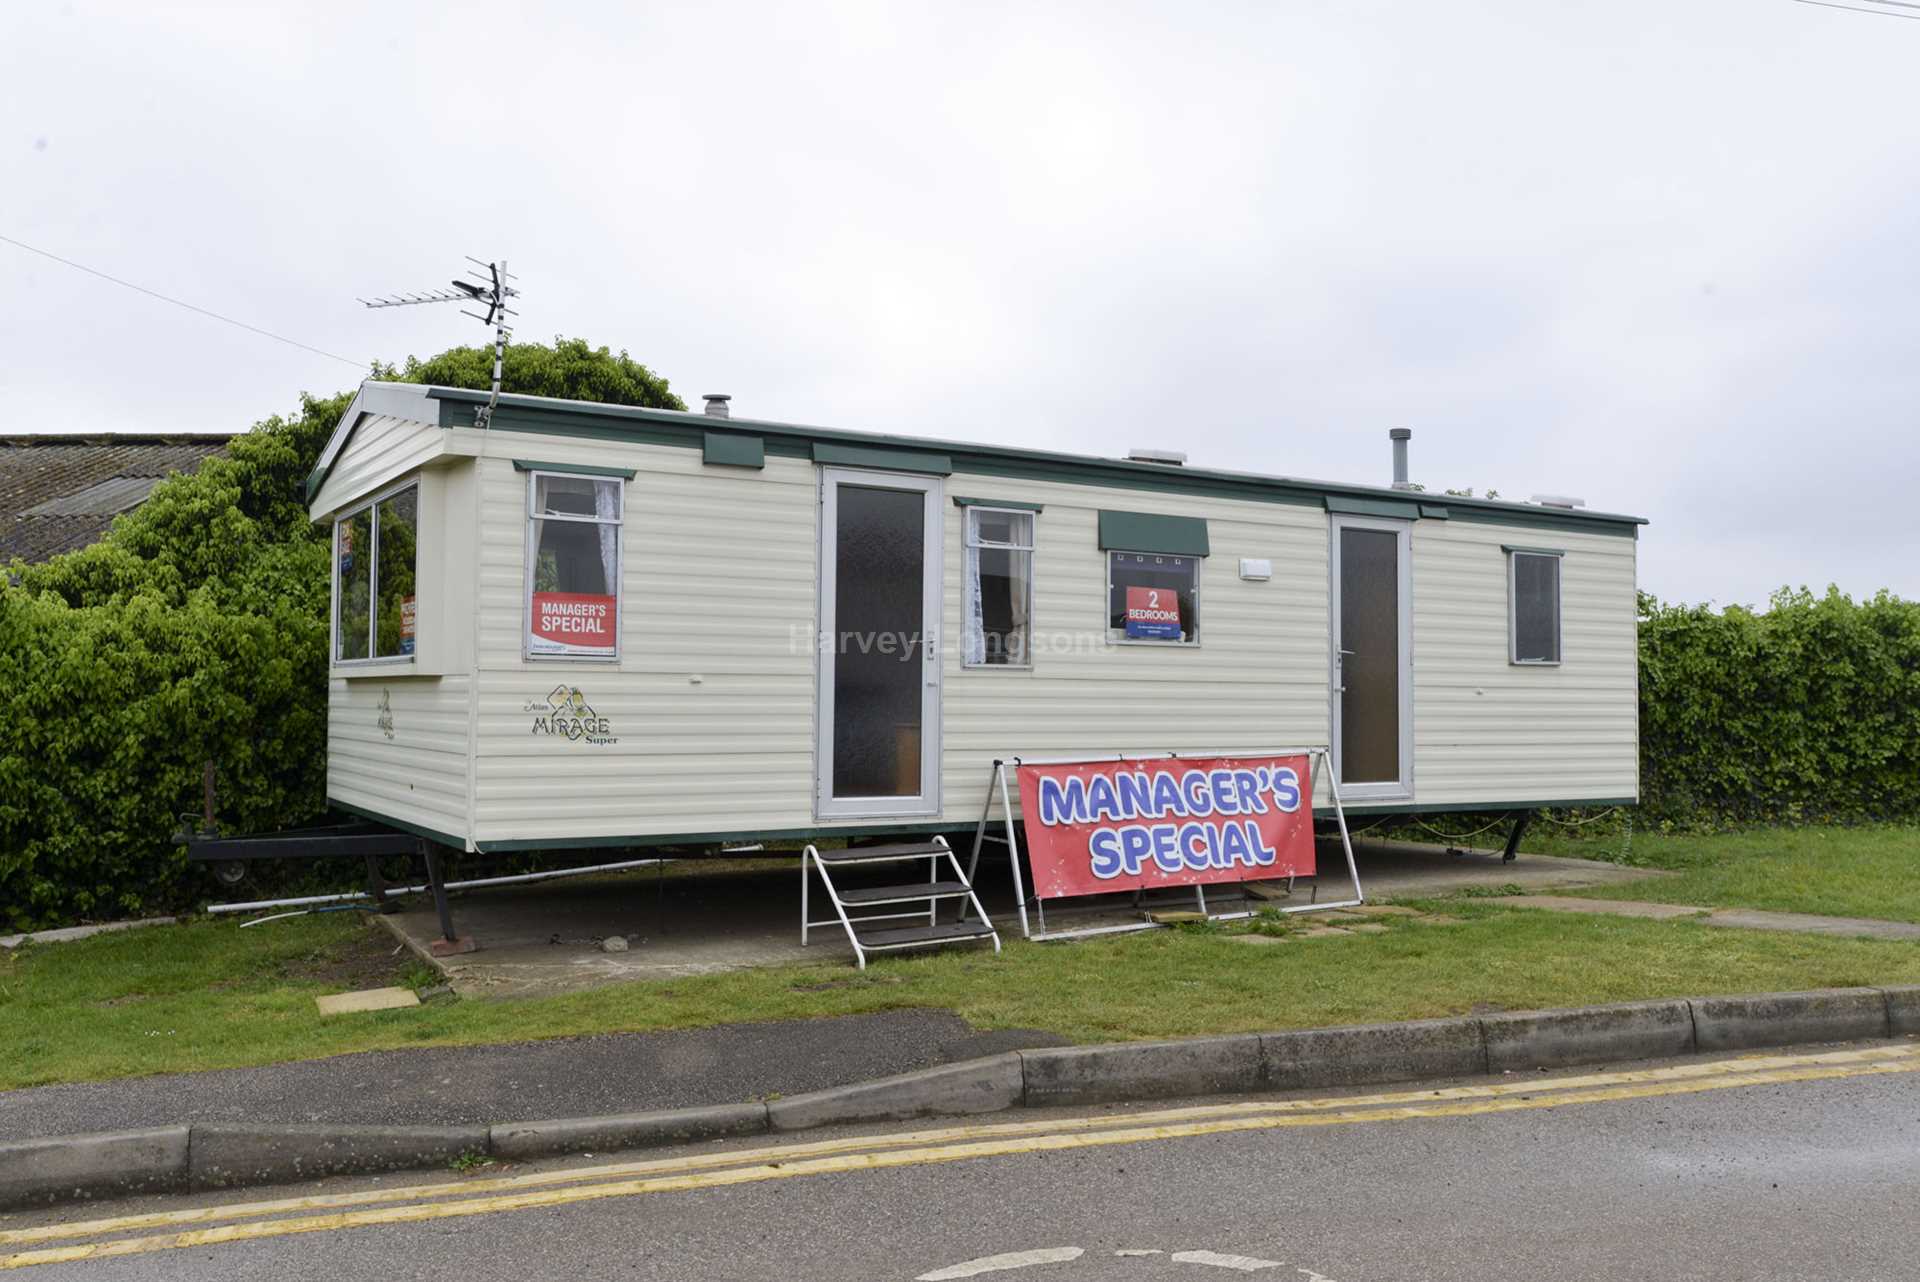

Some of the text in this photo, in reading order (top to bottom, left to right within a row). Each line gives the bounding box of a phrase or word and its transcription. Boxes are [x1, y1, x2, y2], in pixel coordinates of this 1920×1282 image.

[1149, 591, 1159, 608] 2
[542, 602, 607, 617] MANAGER'S
[1129, 608, 1178, 621] BEDROOMS
[541, 616, 606, 633] SPECIAL
[532, 717, 610, 735] MIRAGE
[585, 736, 618, 745] Super
[1038, 766, 1300, 826] MANAGER'S
[1088, 820, 1277, 879] SPECIAL
